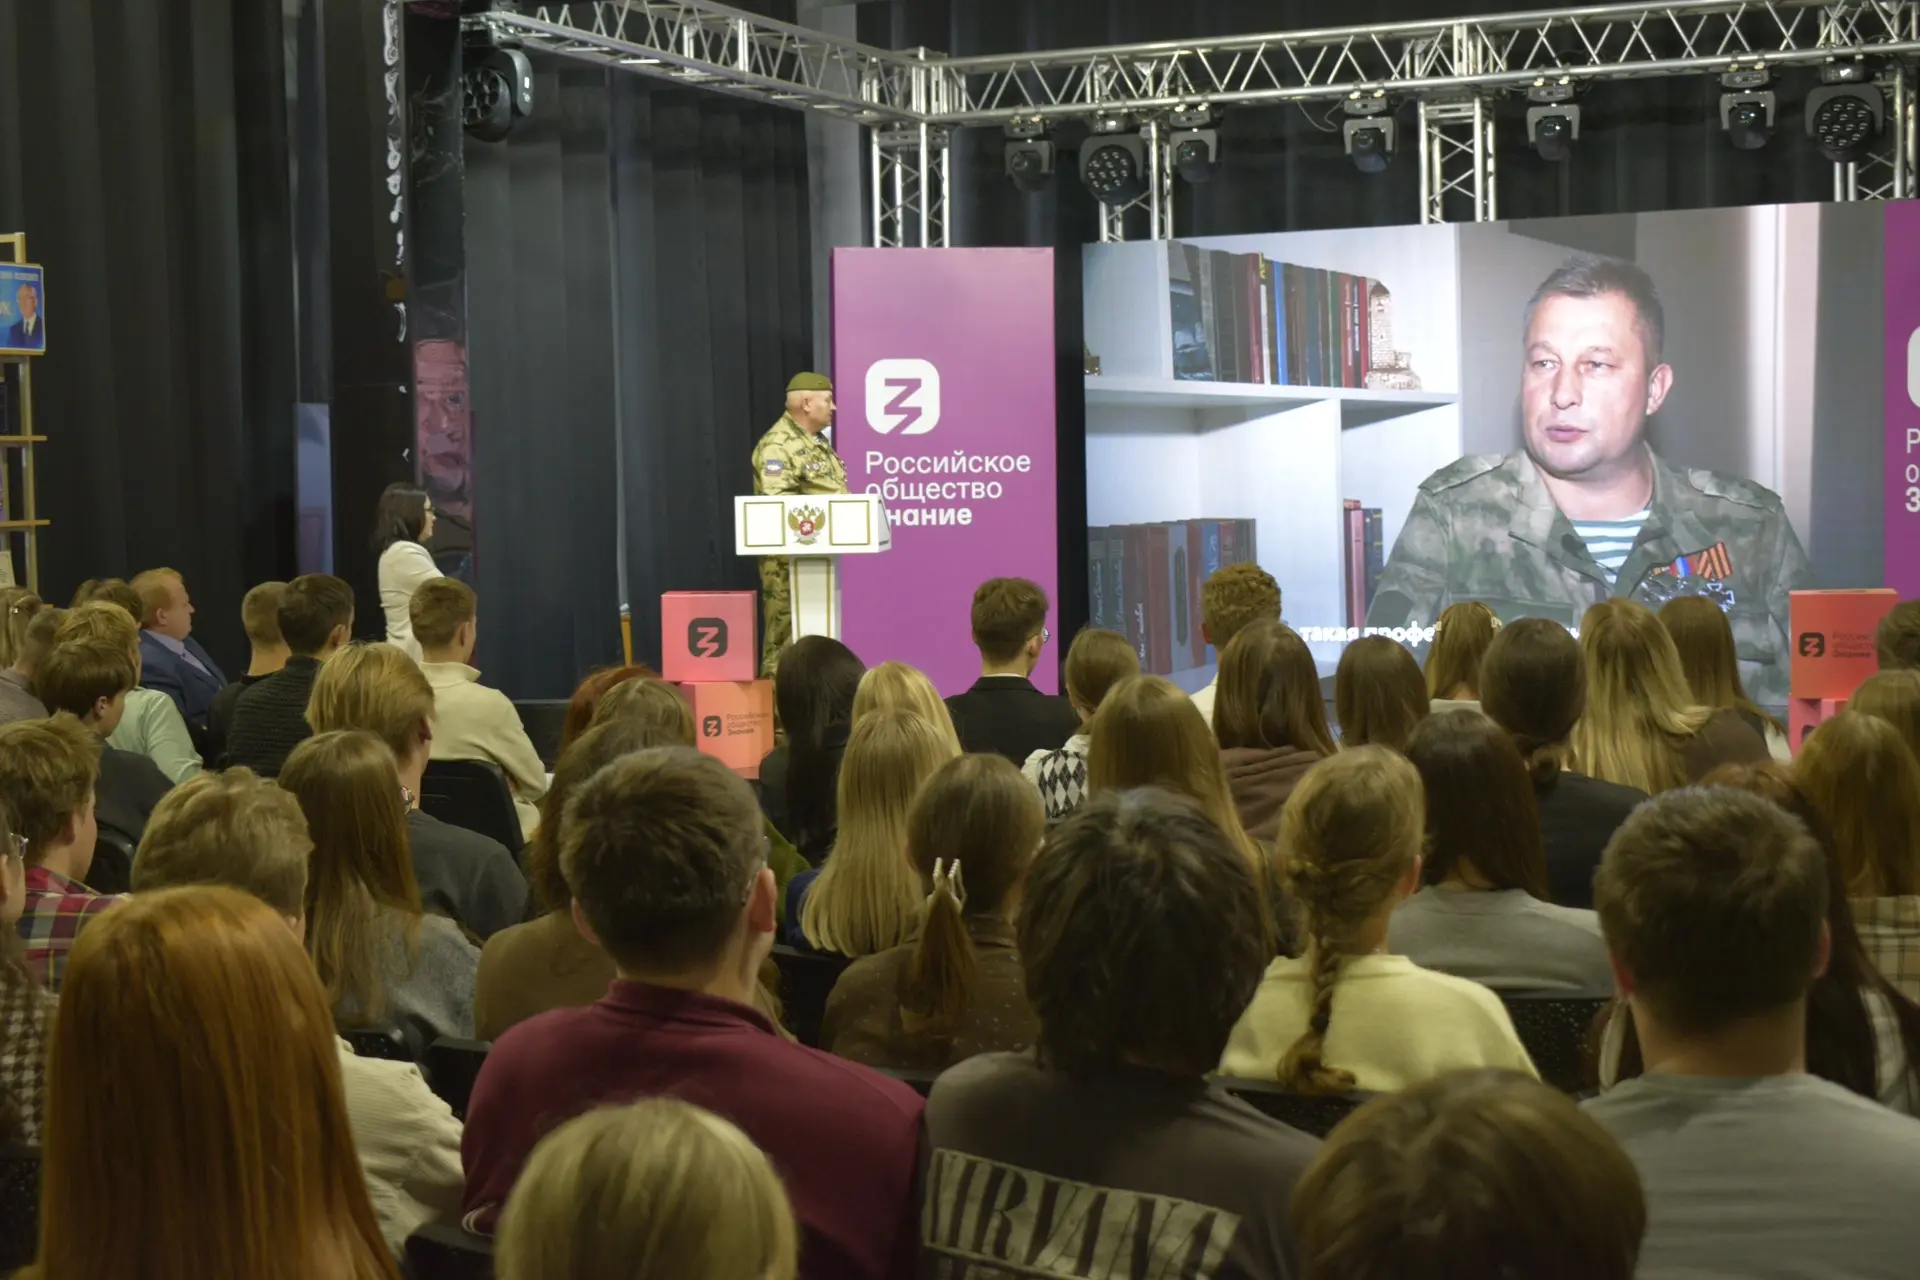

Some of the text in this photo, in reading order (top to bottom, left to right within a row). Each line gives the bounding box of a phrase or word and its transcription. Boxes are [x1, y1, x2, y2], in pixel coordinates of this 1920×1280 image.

[866, 450, 1031, 475] Российское
[865, 477, 1003, 503] общество
[885, 507, 972, 526] нание
[1299, 620, 1436, 647] такая профе
